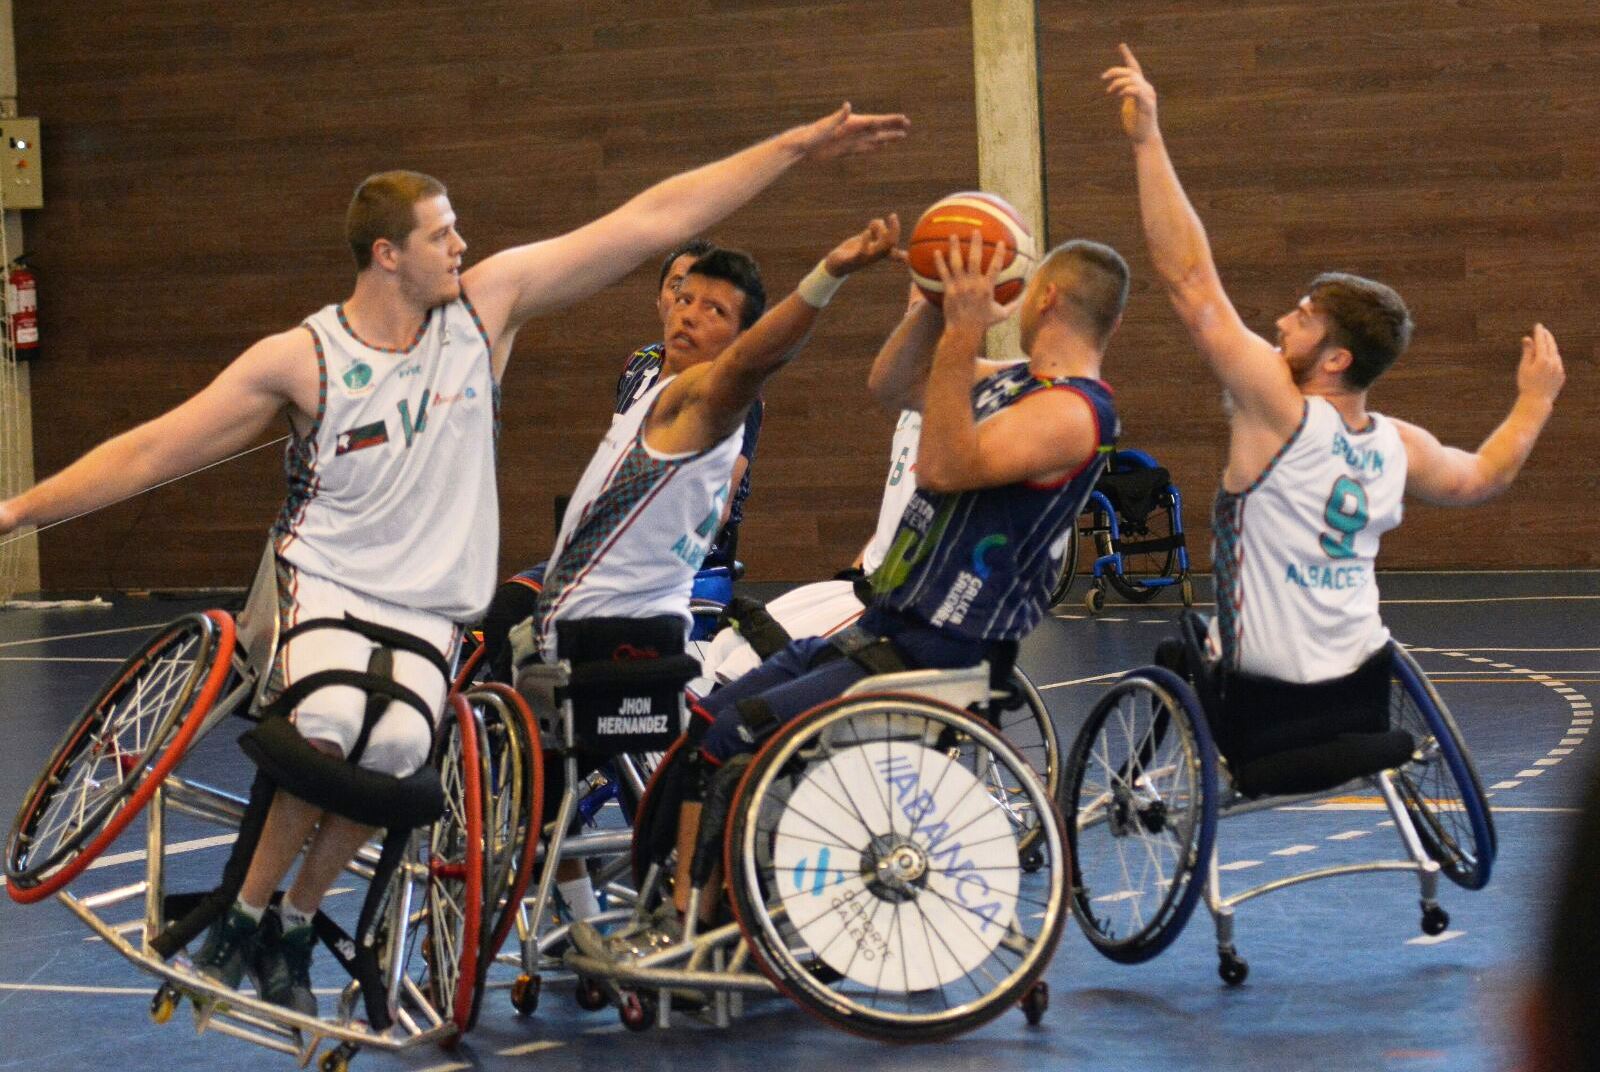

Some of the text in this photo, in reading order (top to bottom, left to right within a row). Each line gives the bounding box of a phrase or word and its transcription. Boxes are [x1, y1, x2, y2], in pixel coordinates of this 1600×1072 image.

[1319, 474, 1369, 559] 9
[597, 715, 669, 735] HERNANDEZ
[618, 697, 652, 716] JHON
[883, 768, 1003, 932] ABANCA
